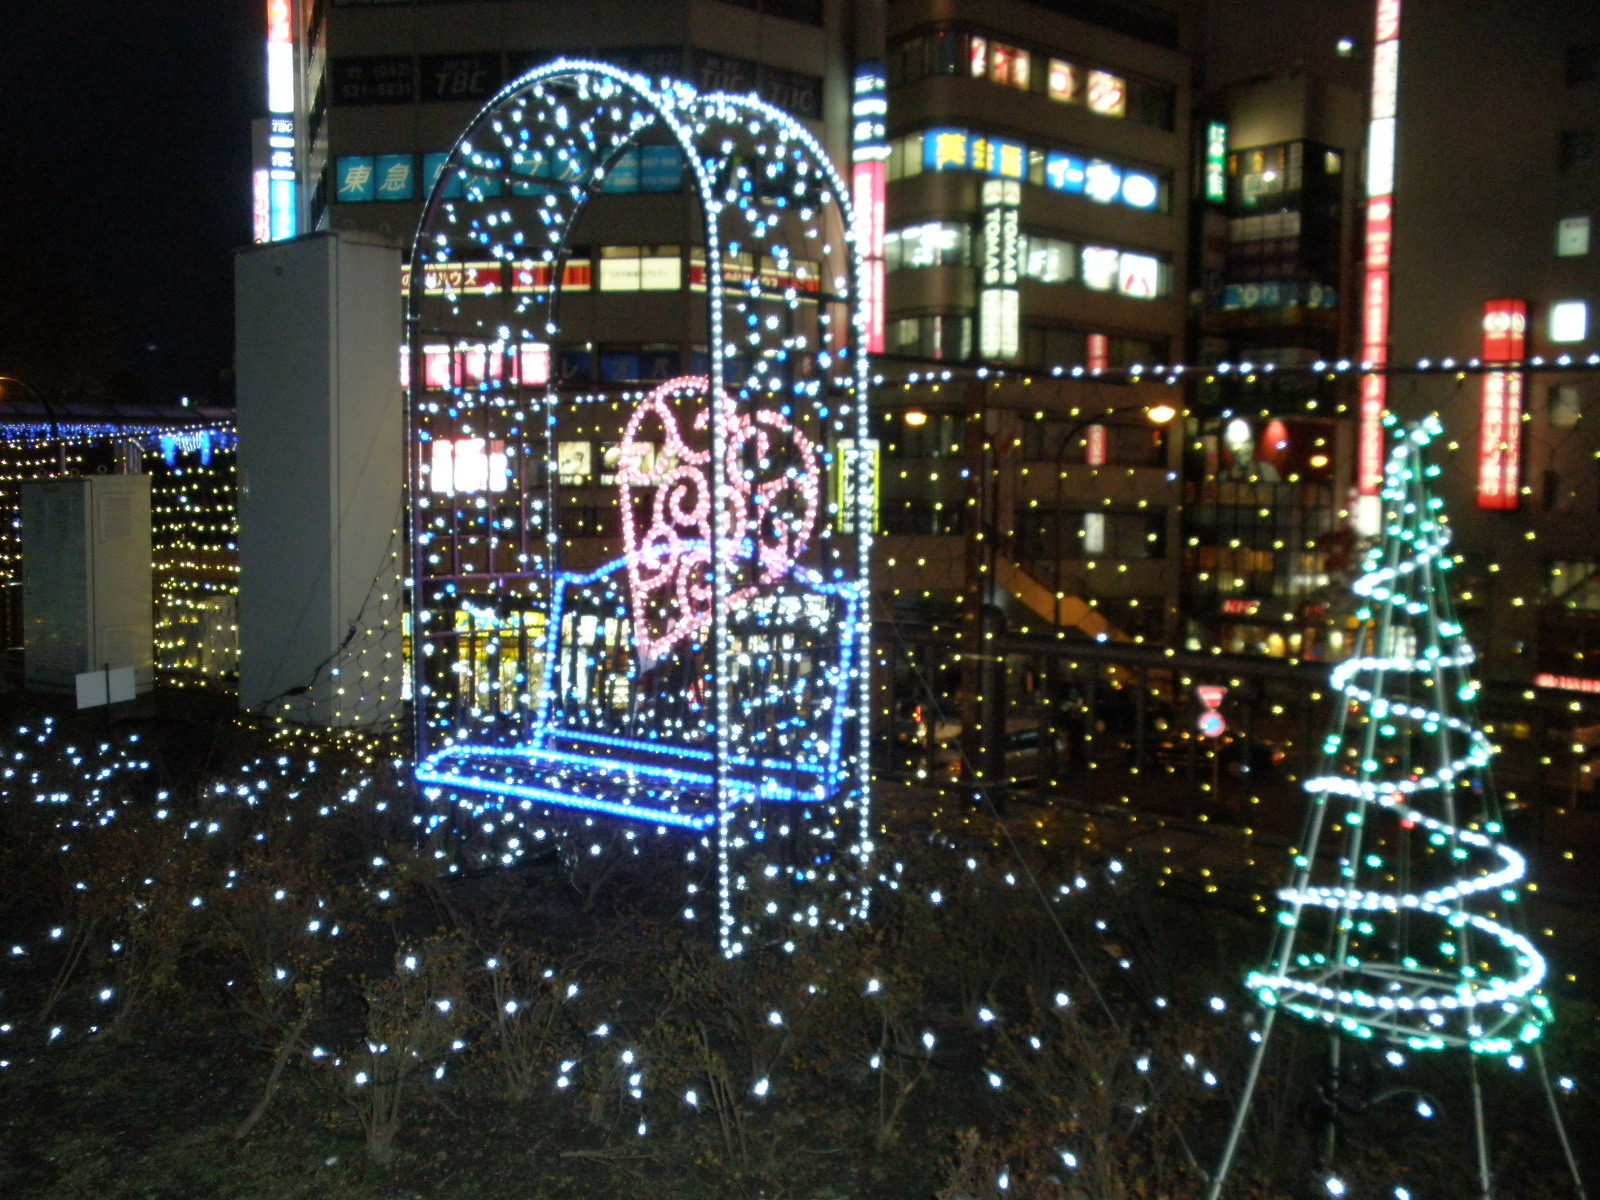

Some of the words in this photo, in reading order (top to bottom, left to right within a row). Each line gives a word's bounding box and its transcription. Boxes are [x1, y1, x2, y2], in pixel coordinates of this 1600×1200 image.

[436, 71, 487, 95] TBC
[984, 207, 1001, 286] TOMAS
[1003, 209, 1019, 286] TOMAS
